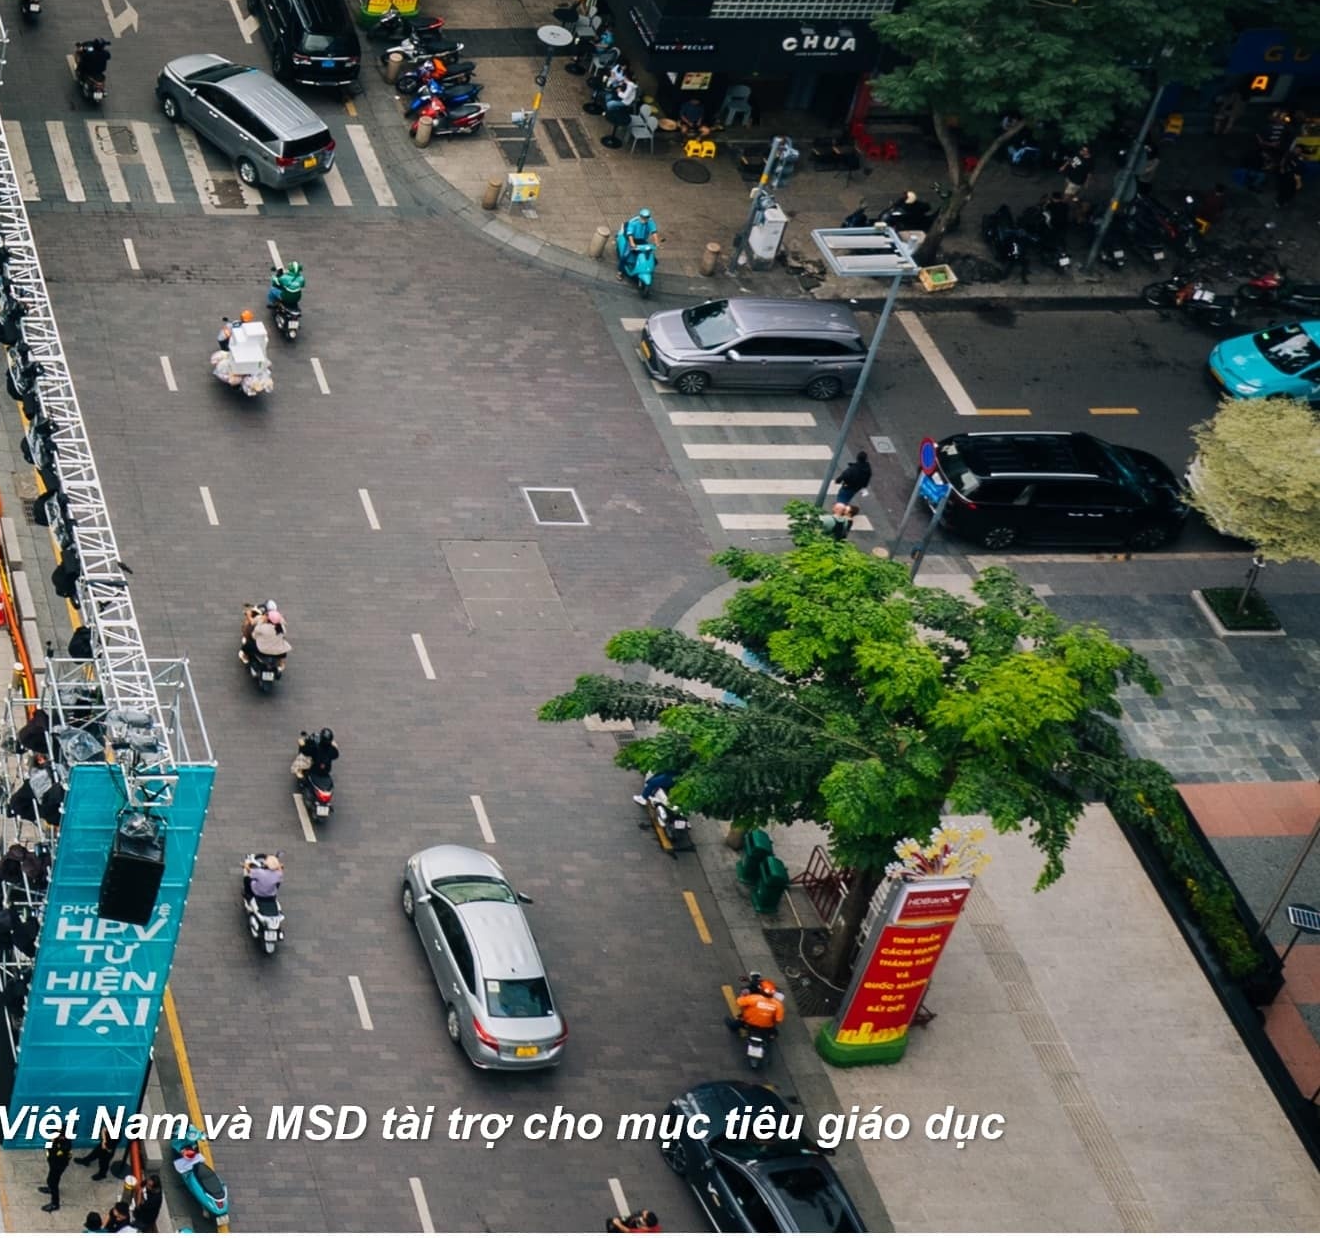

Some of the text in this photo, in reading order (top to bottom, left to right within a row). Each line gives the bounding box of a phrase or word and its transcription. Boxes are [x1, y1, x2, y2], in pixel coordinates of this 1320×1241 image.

[782, 35, 857, 51] CHUA
[908, 896, 950, 906] HDBank
[56, 918, 169, 940] HPV
[77, 940, 141, 964] TỪ
[46, 967, 157, 997] HIỆN
[43, 997, 152, 1035] TẠI
